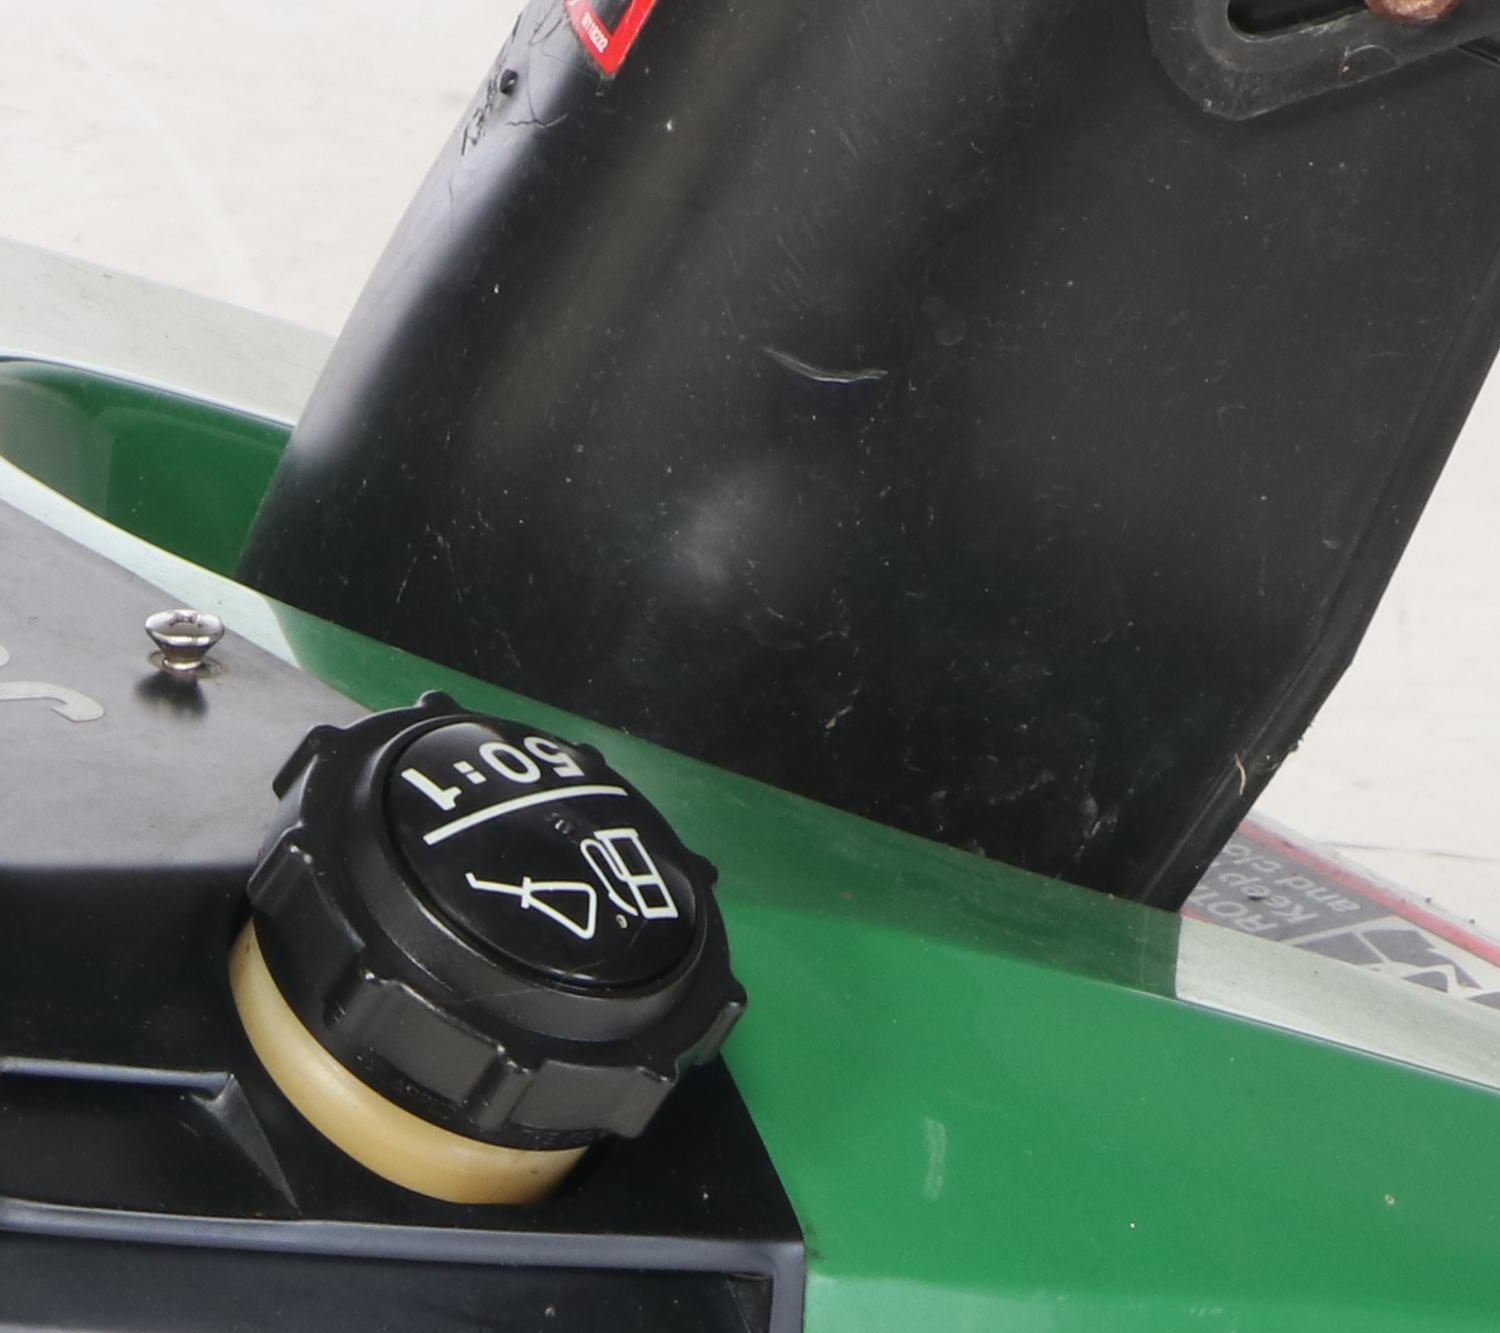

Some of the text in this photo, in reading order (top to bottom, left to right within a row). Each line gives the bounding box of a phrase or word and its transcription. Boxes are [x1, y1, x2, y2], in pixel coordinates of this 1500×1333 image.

[401, 736, 585, 811] 50:1
[1217, 872, 1319, 923] Keep
[1274, 875, 1361, 912] and
